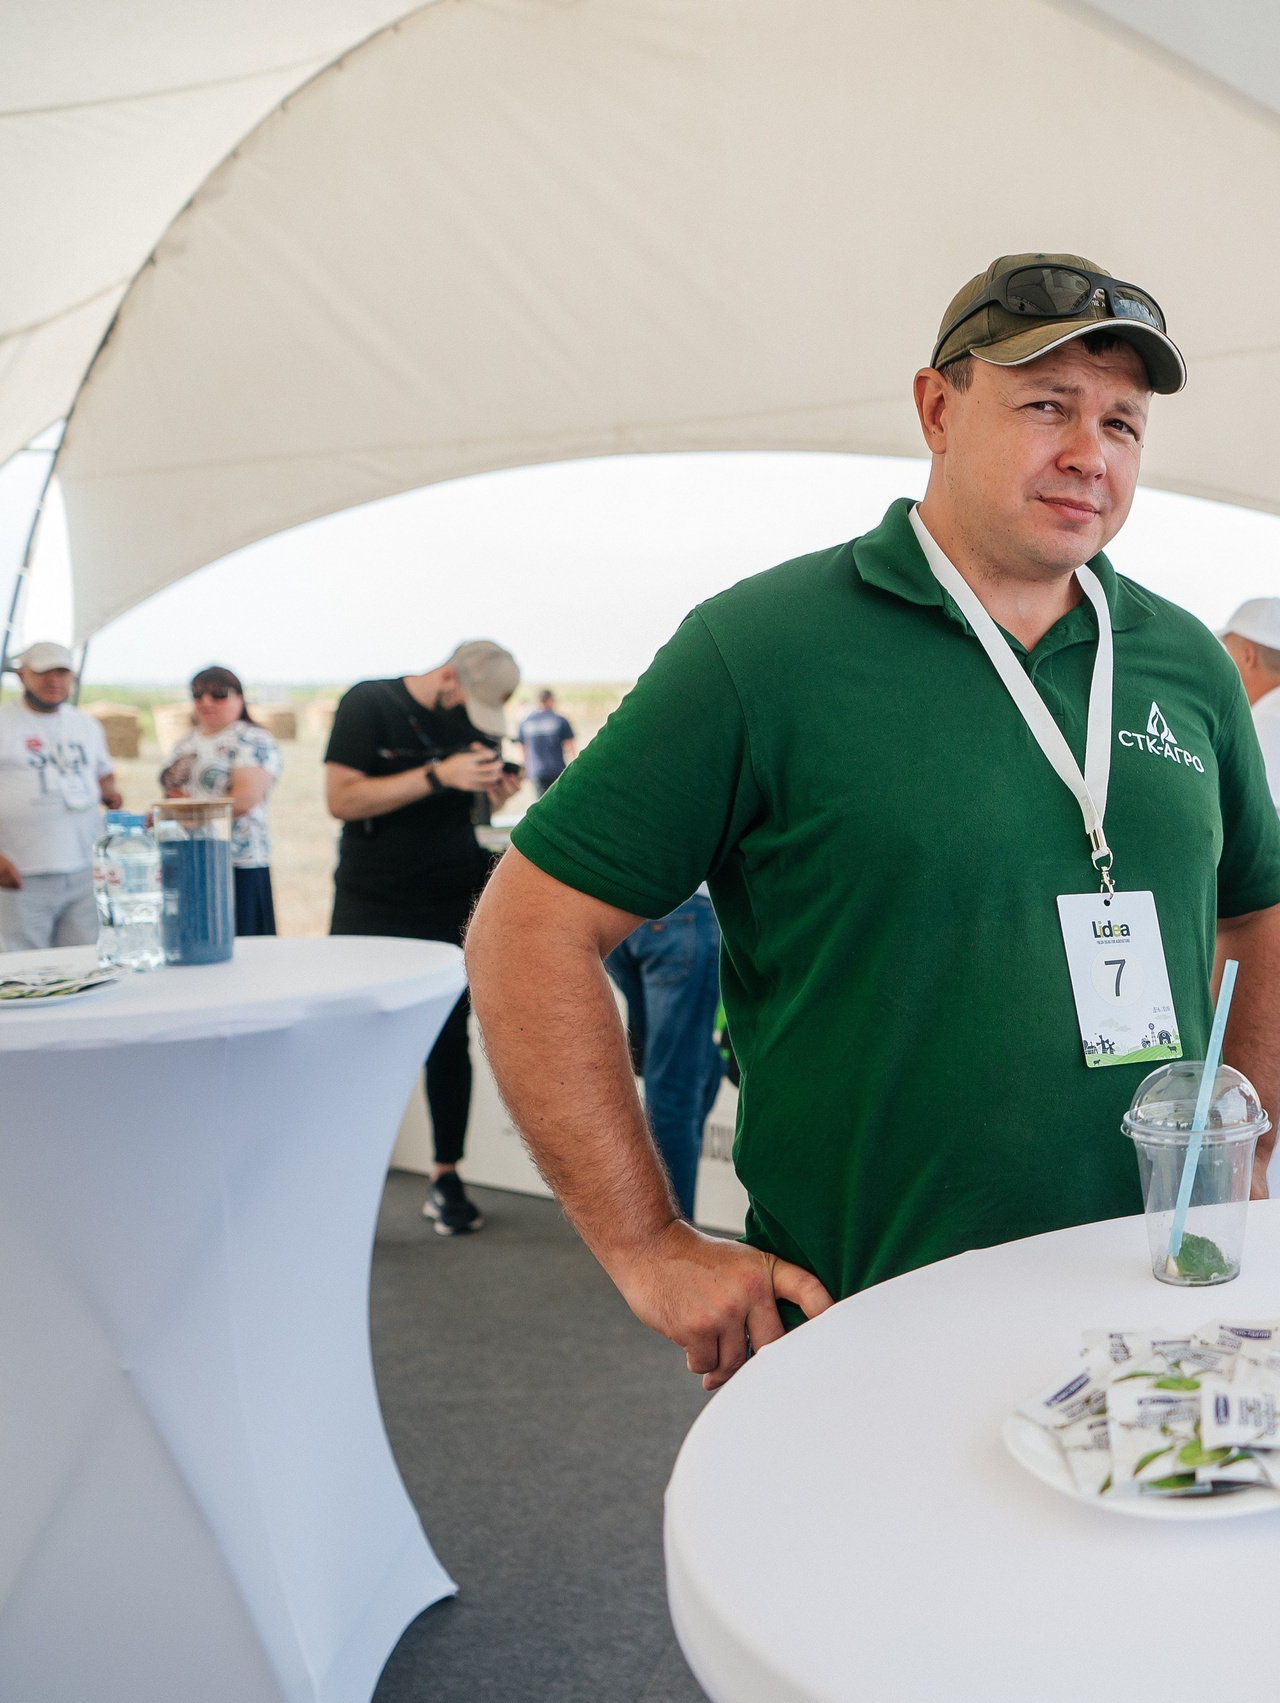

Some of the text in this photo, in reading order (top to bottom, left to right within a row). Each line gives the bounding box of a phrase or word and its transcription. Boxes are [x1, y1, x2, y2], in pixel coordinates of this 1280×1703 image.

[1118, 729, 1205, 773] СТК-АГРО
[1091, 920, 1131, 938] Lidea
[1103, 958, 1126, 998] 7
